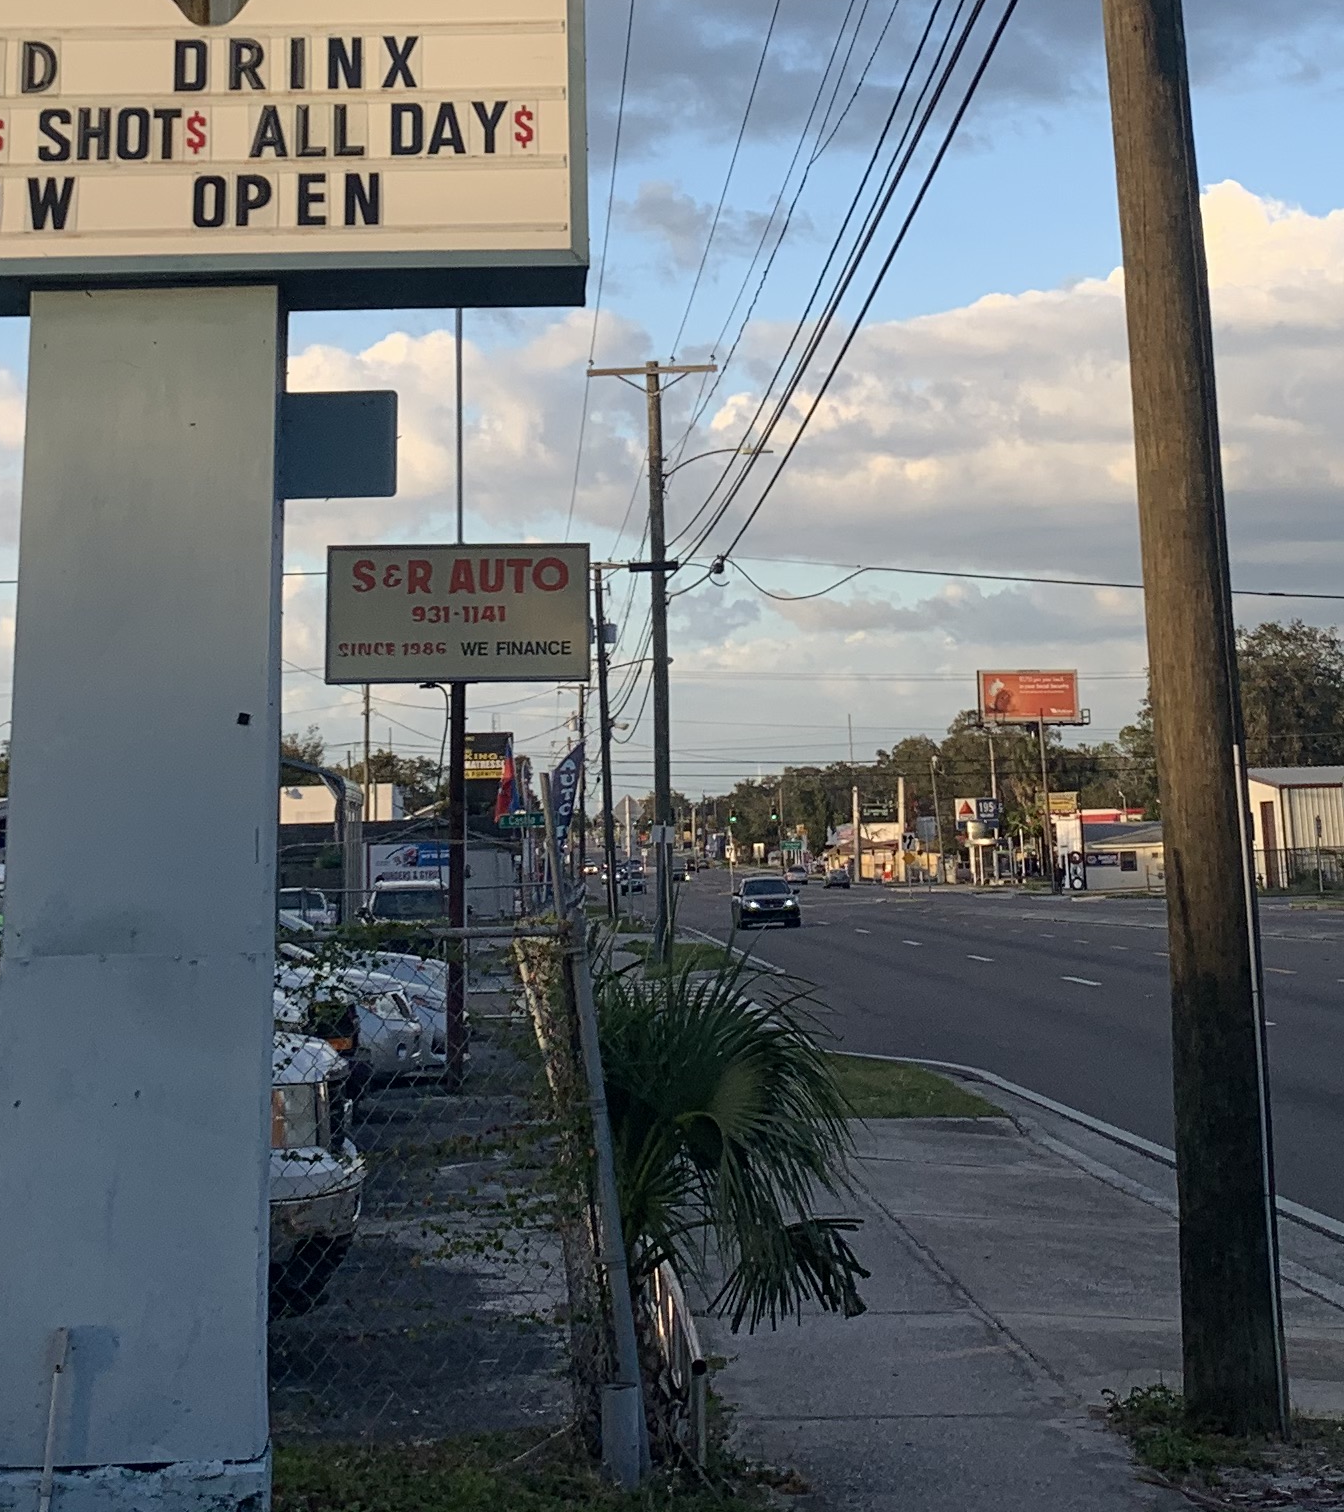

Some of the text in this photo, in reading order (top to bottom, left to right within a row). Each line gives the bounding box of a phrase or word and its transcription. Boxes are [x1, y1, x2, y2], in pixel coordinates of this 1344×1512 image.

[173, 36, 419, 92] DRINX
[38, 107, 208, 162] SHOT$
[249, 103, 366, 158] ALL
[390, 100, 534, 156] DAY$
[192, 172, 380, 228] OPEN
[448, 557, 570, 595] AUTO
[411, 605, 507, 625] 931-1141
[337, 640, 572, 658] SINCE 1986 WE FINANCE
